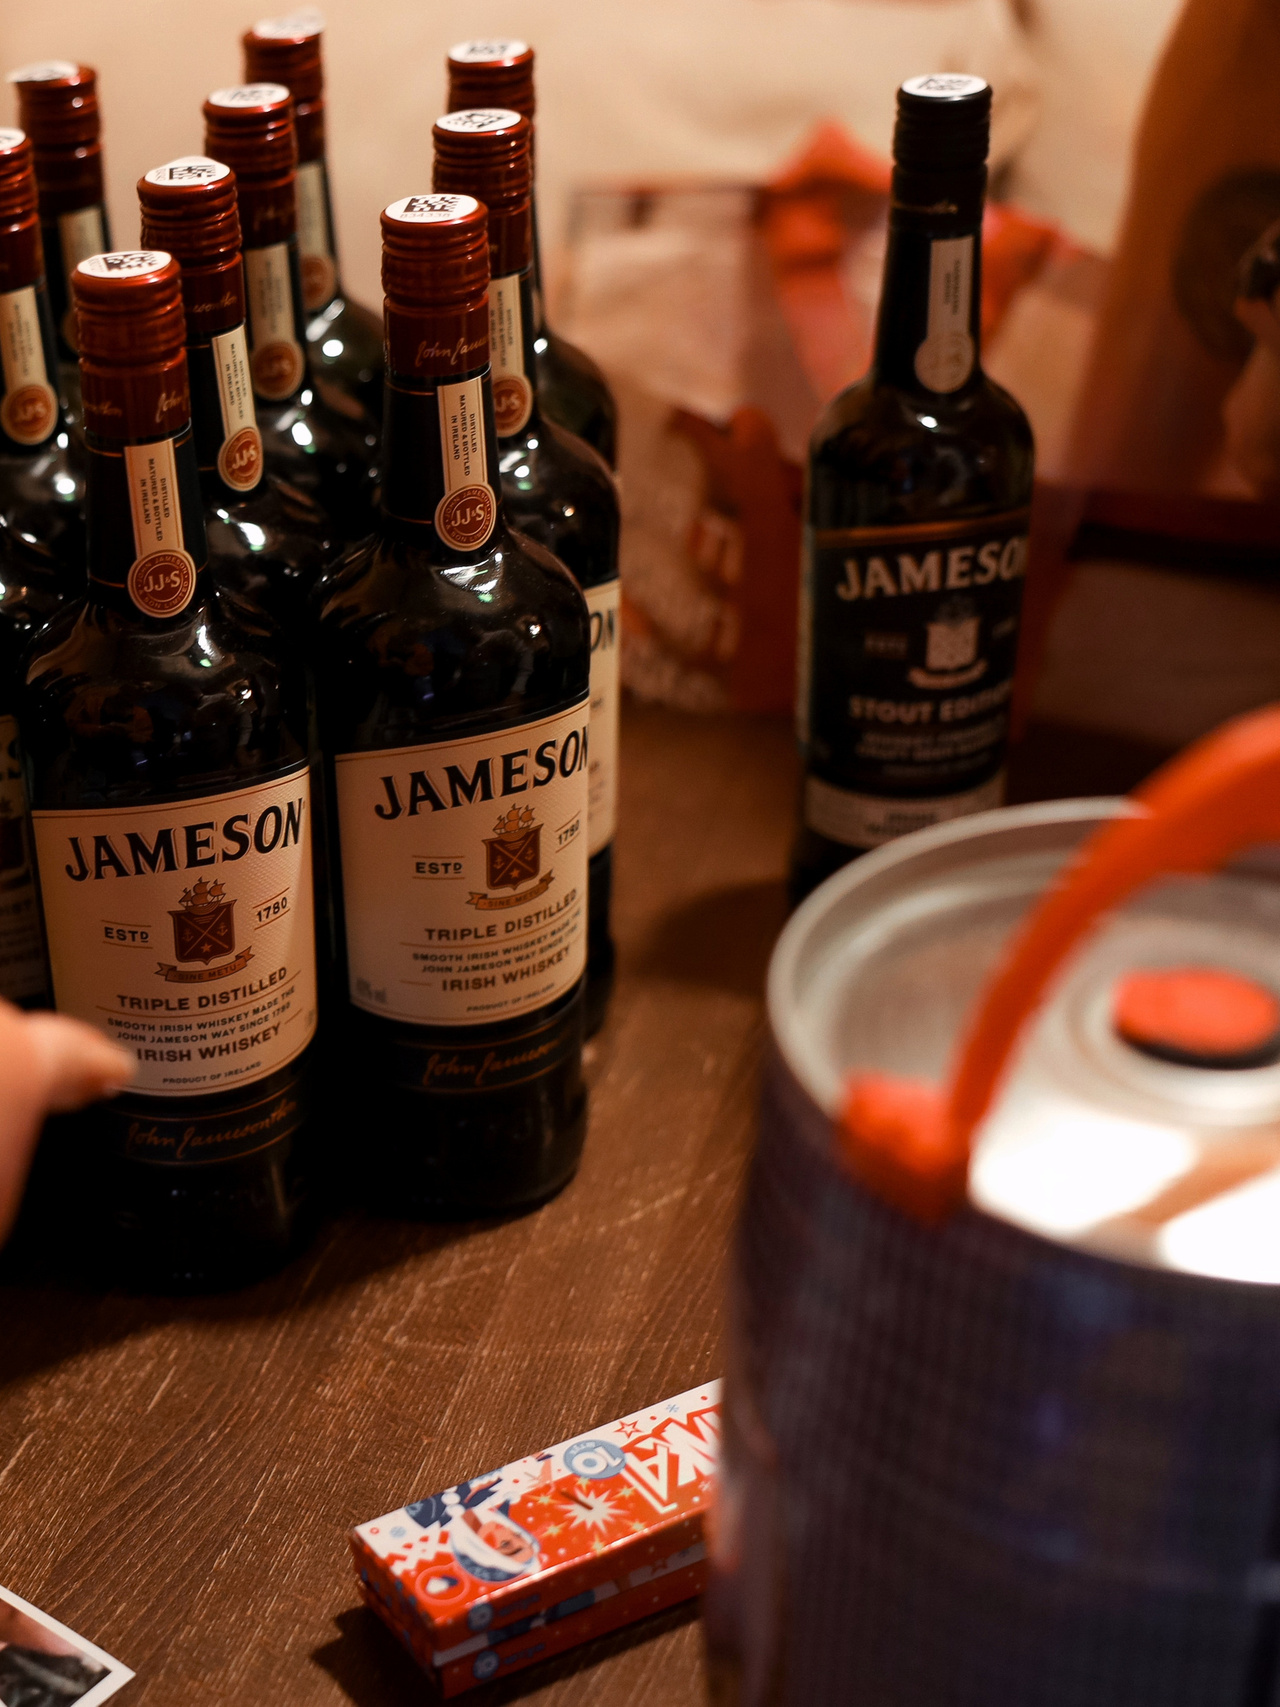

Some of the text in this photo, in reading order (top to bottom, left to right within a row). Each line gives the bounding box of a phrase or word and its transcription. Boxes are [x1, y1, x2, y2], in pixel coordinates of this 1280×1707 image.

[460, 394, 468, 430] MATURED
[452, 424, 461, 460] IRELAND
[469, 413, 477, 453] DISTILLED
[463, 438, 471, 477] BOTTLED
[141, 488, 151, 525] IRELAND
[148, 458, 158, 498] MATURED
[154, 505, 163, 542] BOTTLED
[161, 477, 170, 518] DISTILLED
[64, 797, 303, 882] JAMESON
[256, 896, 289, 922] 1780
[424, 888, 578, 941] TRIPLE DISTILLED
[412, 953, 463, 962] SMOOTH
[467, 949, 499, 960] IRISH
[502, 934, 549, 955] WHISKEY
[421, 964, 453, 974] JOHN
[457, 958, 511, 973] JAMESON
[515, 951, 536, 964] WAY
[208, 965, 238, 979] METU
[441, 946, 572, 992] IRISH WHISKEY
[116, 966, 288, 1012] TRIPLE DISTILLED
[107, 986, 295, 1032] SMOOTH IRISH WHISKEY MADE THE
[117, 1032, 146, 1043] JOHN
[149, 1032, 207, 1044] JAMESON
[211, 1026, 236, 1039] WAY
[239, 1014, 270, 1033] SINCE
[136, 1021, 281, 1062] IRISH WHISKEY
[162, 1061, 262, 1084] PRODUCT OF IRELAND
[572, 1446, 624, 1475] 10
